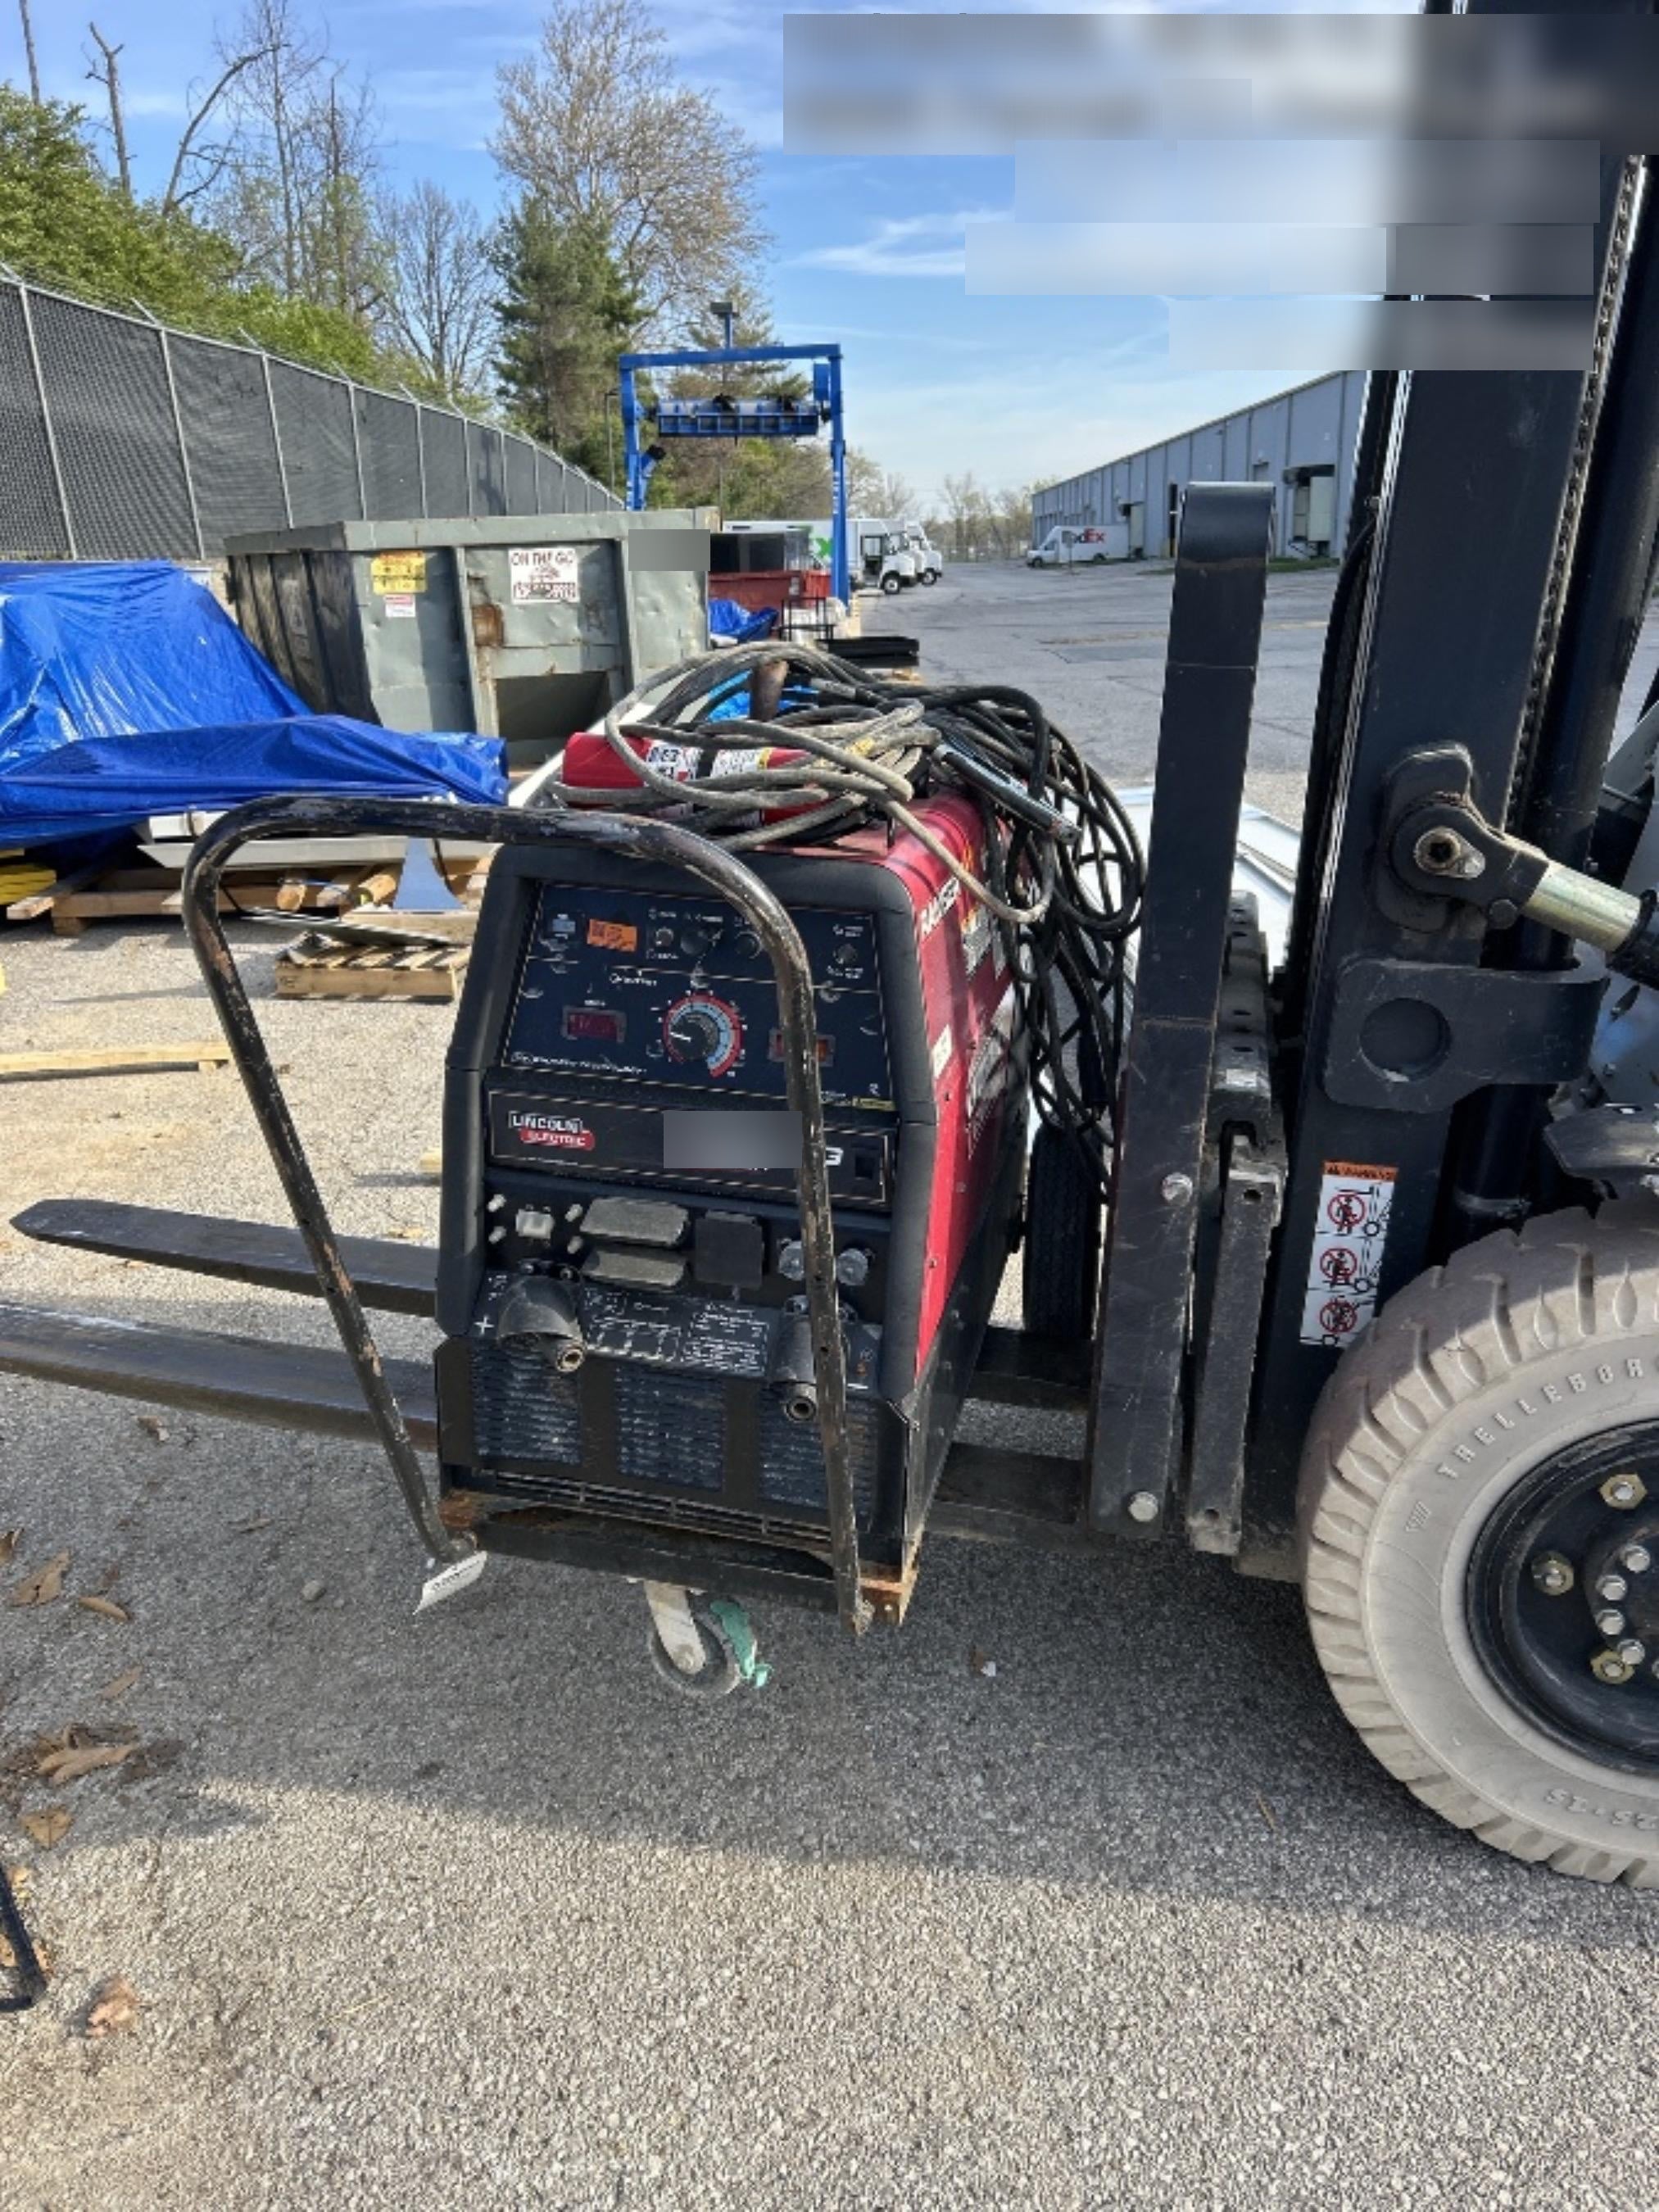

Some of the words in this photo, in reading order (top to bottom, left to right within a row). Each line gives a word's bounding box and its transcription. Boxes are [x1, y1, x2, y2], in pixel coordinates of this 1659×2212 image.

[511, 552, 529, 565] ON
[555, 551, 573, 564] GO
[512, 1115, 578, 1133] LINCOLN
[526, 1130, 587, 1147] ELECTRIC
[1435, 1358, 1659, 1479] TRELLEBOR
